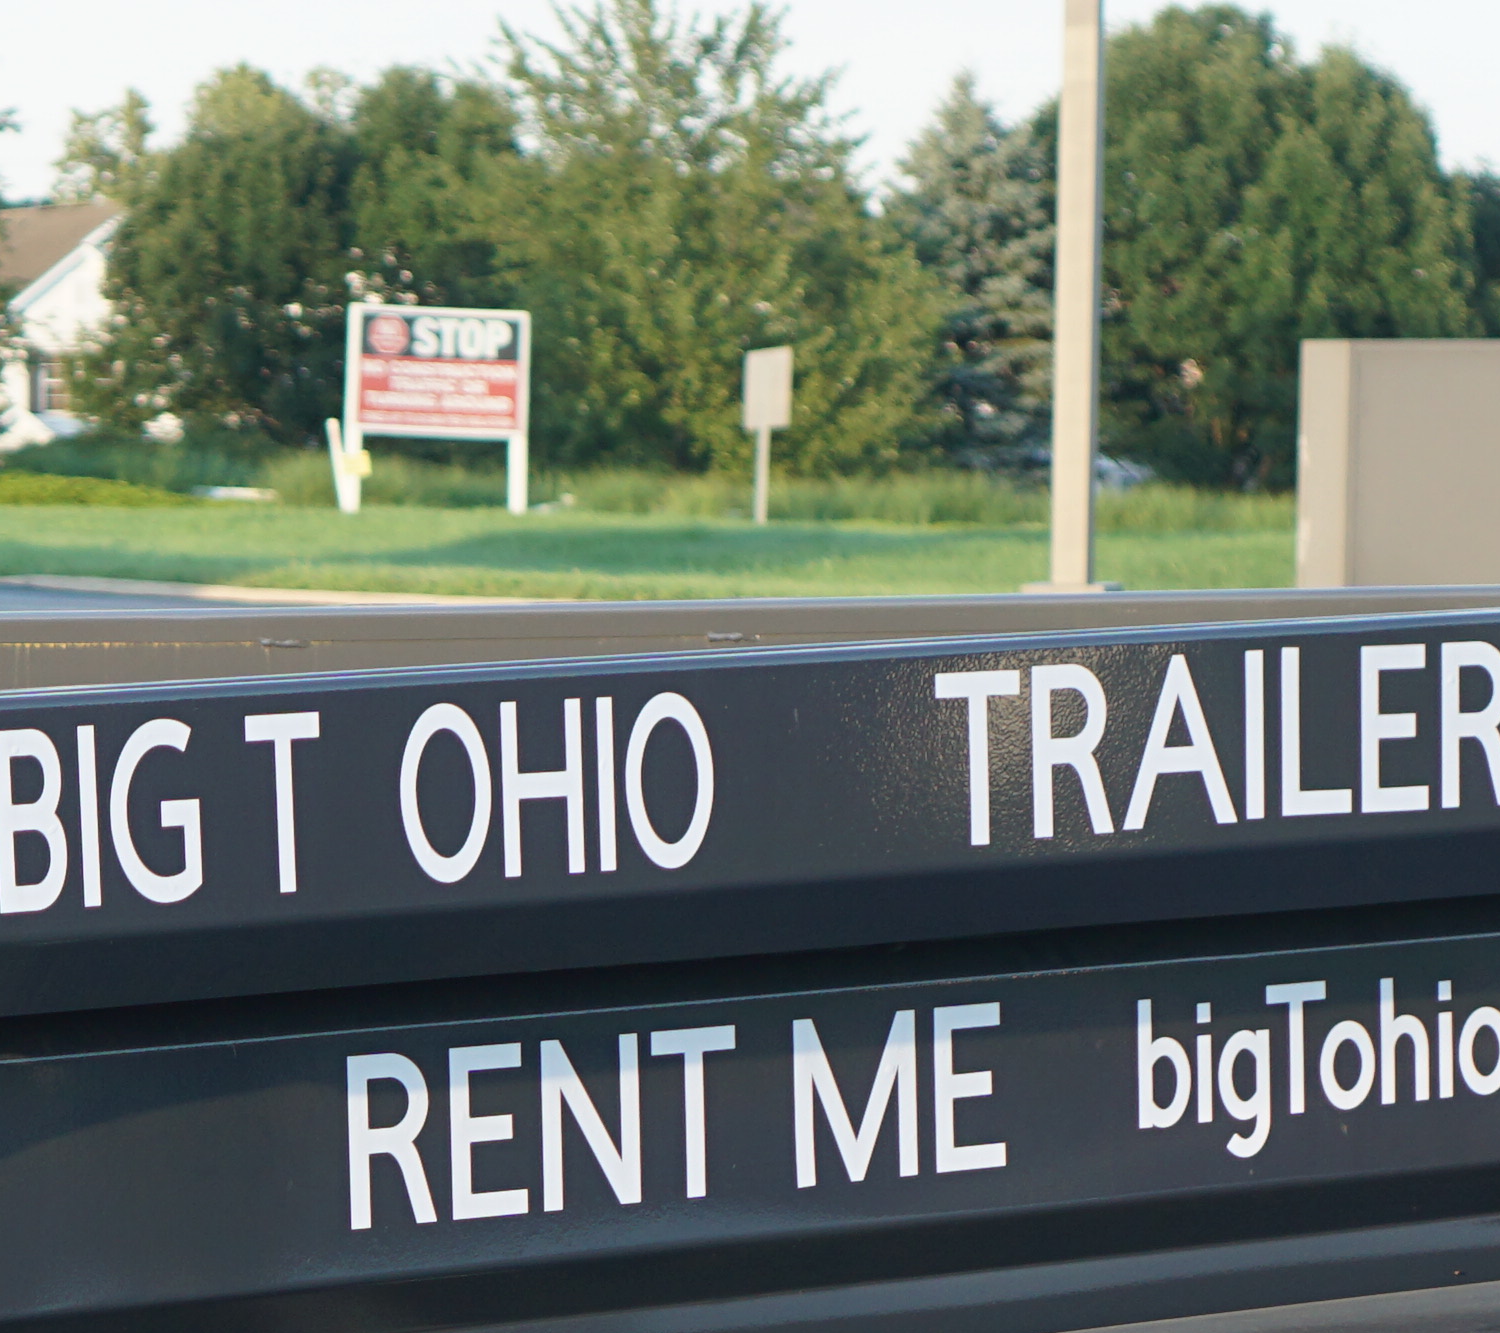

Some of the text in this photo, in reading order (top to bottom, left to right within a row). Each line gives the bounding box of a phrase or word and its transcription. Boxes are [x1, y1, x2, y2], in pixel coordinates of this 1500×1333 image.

[411, 315, 513, 361] STOP
[244, 711, 320, 895] T
[399, 691, 715, 884] OHIO
[346, 1023, 737, 1231] RENT
[791, 1001, 1007, 1189] ME
